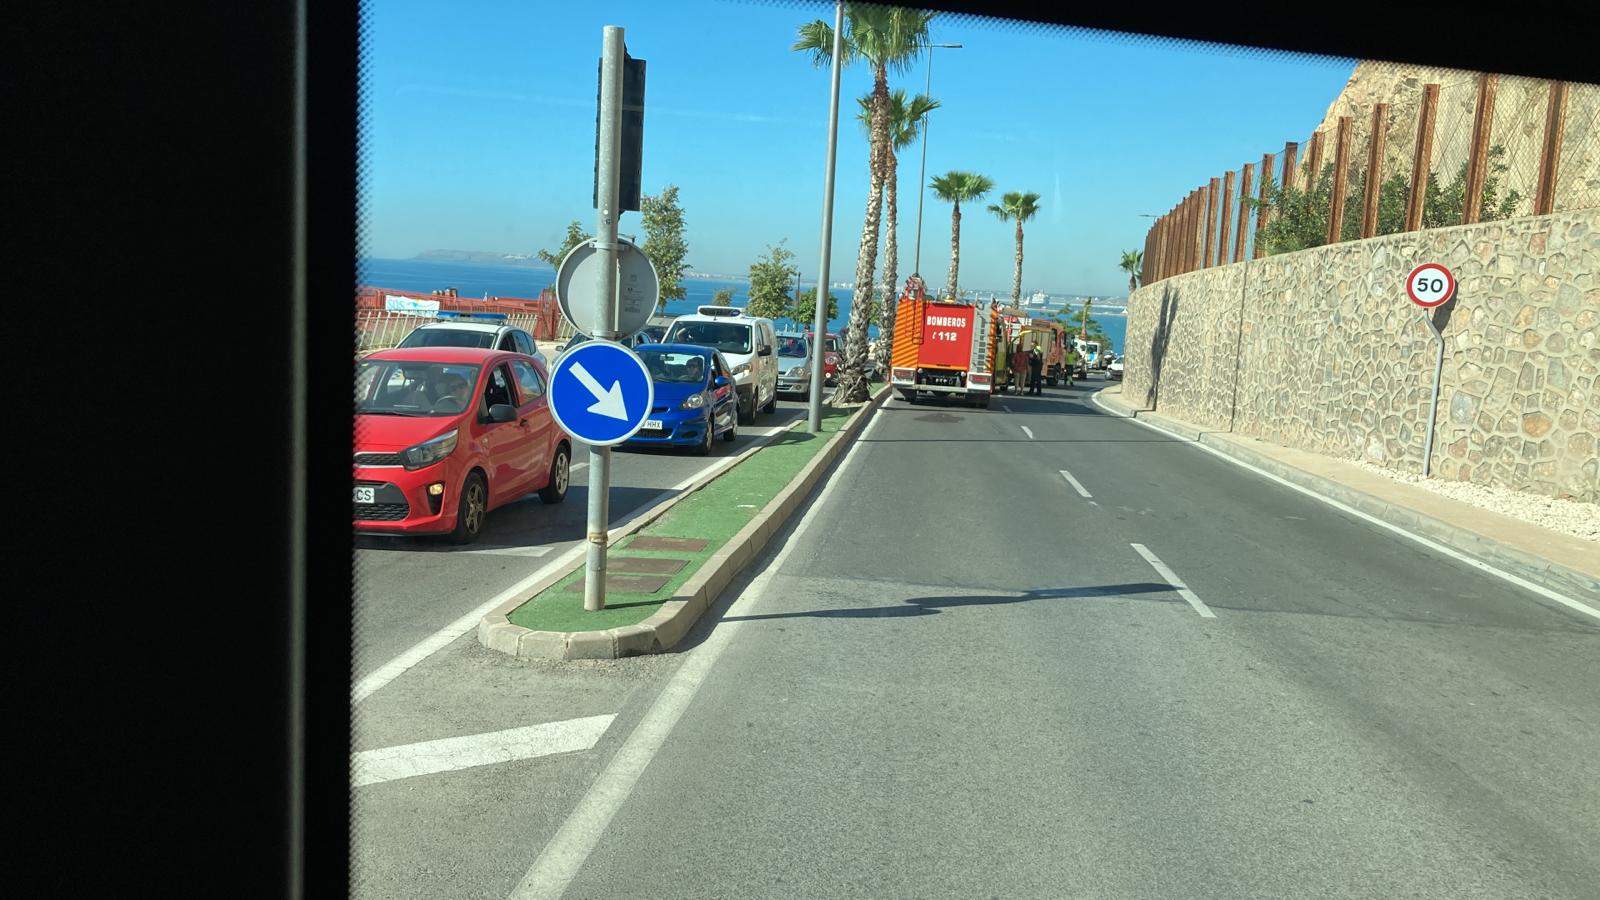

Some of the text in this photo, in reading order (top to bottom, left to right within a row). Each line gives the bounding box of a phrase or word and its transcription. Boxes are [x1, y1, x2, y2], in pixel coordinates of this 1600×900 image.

[1417, 277, 1443, 293] 50
[926, 315, 966, 328] BOMBEROS
[938, 331, 957, 341] 112
[351, 489, 371, 501] CS
